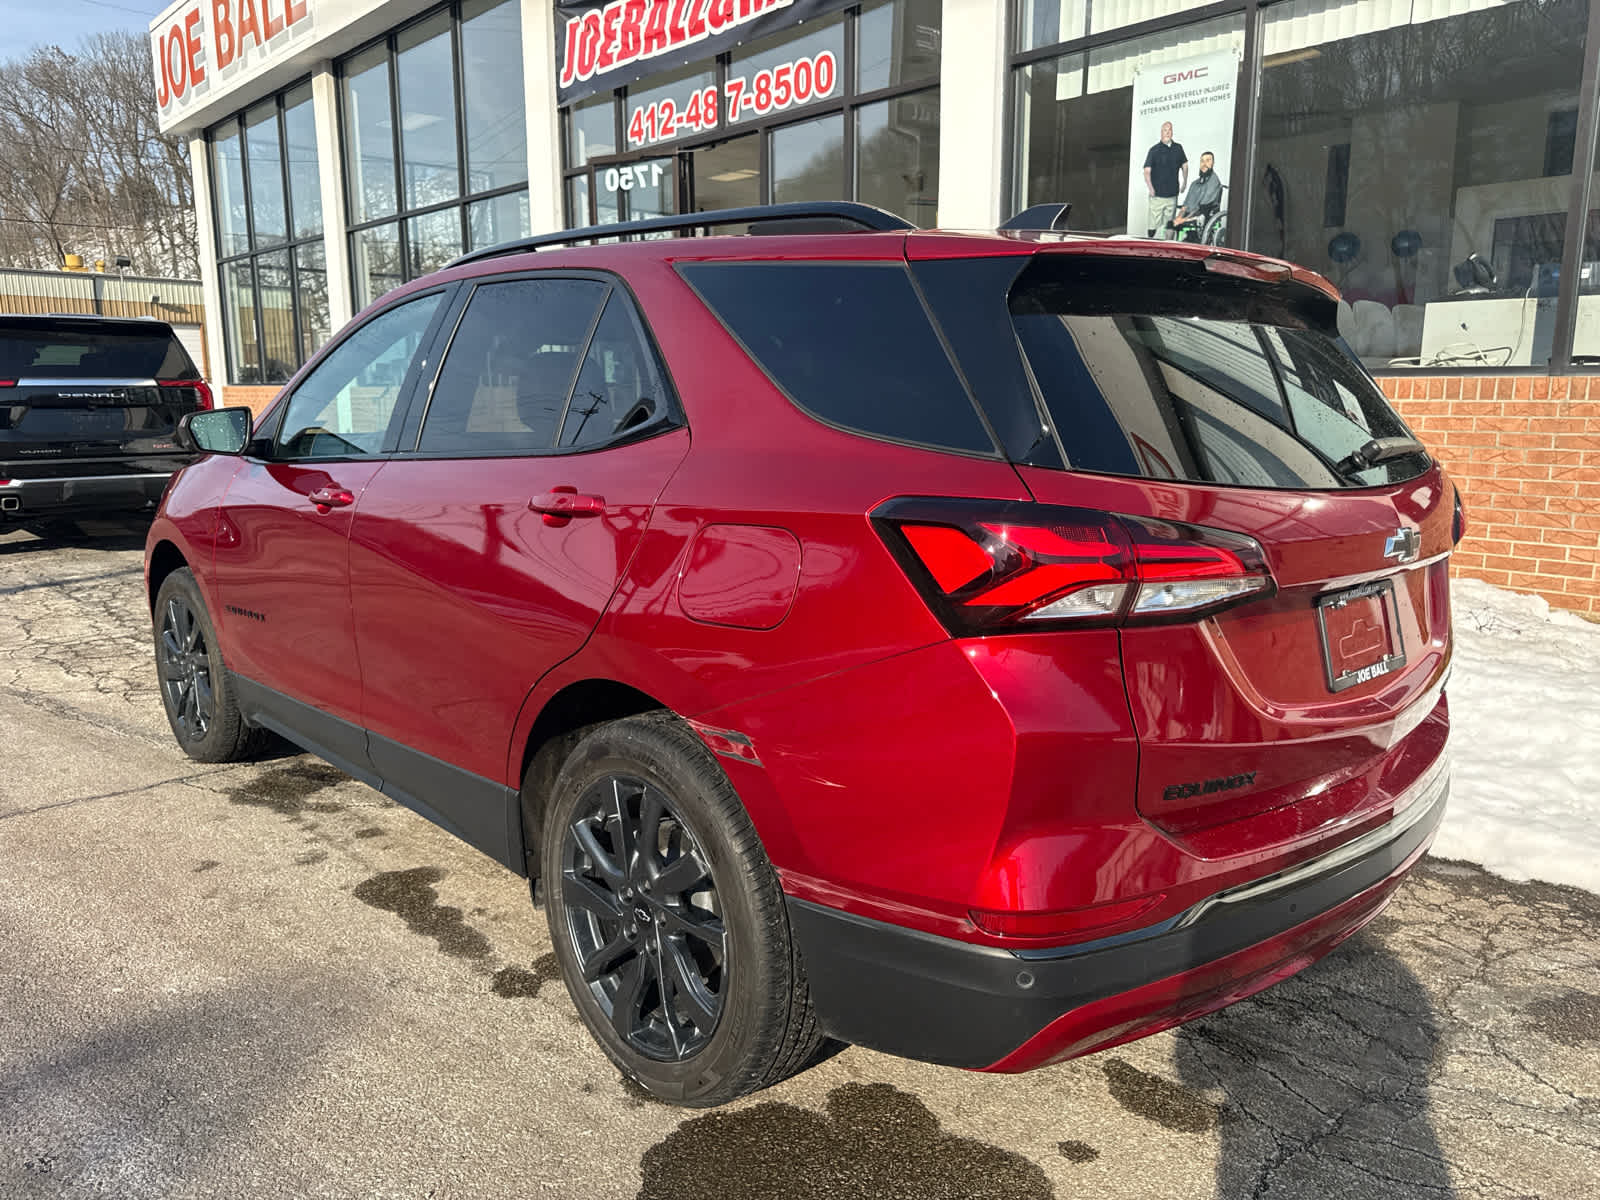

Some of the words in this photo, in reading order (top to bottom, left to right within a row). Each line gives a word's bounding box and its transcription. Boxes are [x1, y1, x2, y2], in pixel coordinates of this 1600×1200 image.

[157, 8, 206, 109] JOE
[1163, 67, 1208, 84] GMC
[1173, 88, 1203, 100] SEVERELY
[1203, 82, 1230, 94] INJURED
[1140, 103, 1170, 115] VETERANS
[1171, 100, 1187, 110] NEED
[1187, 96, 1208, 107] SMART
[1209, 92, 1232, 103] HOMES
[1356, 668, 1372, 684] JOE
[1371, 661, 1390, 679] BALL
[1162, 771, 1258, 801] EQUINOX
